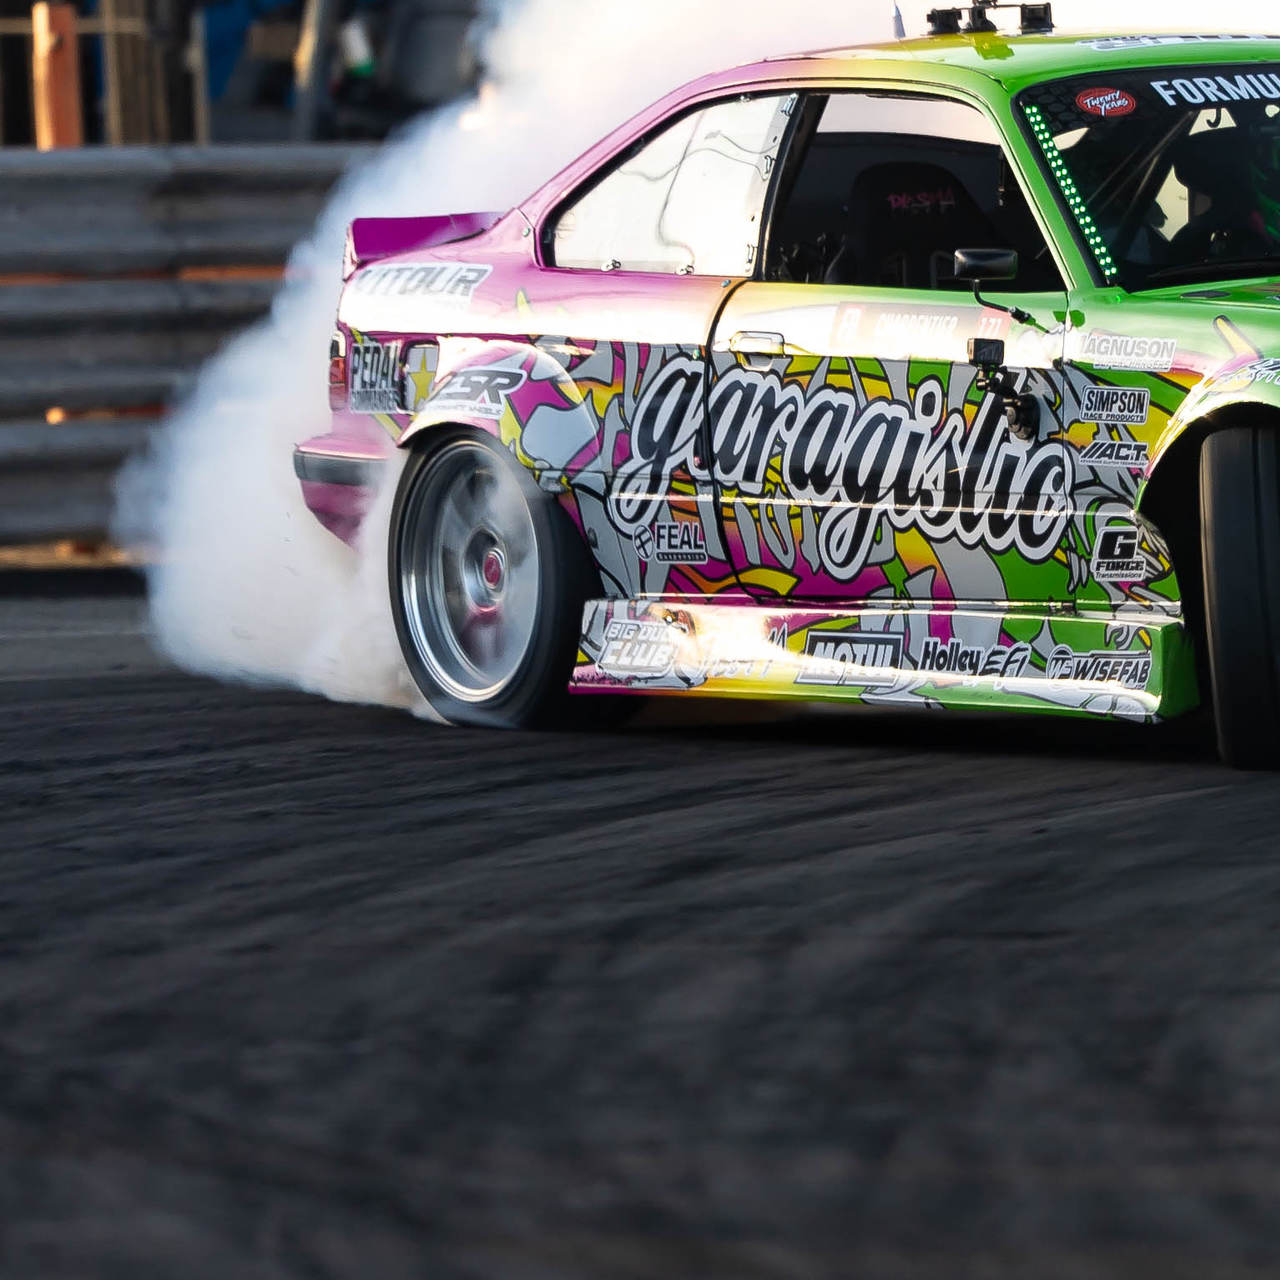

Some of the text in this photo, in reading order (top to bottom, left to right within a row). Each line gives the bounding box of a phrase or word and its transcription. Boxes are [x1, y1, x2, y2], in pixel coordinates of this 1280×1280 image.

[1083, 90, 1120, 109] TWENTY
[1097, 97, 1129, 116] YEARS
[352, 345, 400, 389] PEDAL
[1085, 390, 1146, 414] SIMPSON
[1084, 412, 1144, 422] RACE PRODUCTS
[607, 355, 1074, 581] garagistic
[656, 523, 704, 550] FEAL
[1098, 530, 1138, 560] G
[1095, 560, 1145, 572] FORCE
[1096, 571, 1142, 579] Transmissions
[607, 624, 638, 640] BIG
[603, 641, 674, 668] CLUB
[923, 640, 982, 676] Holley
[1073, 658, 1151, 684] WISEFAB
